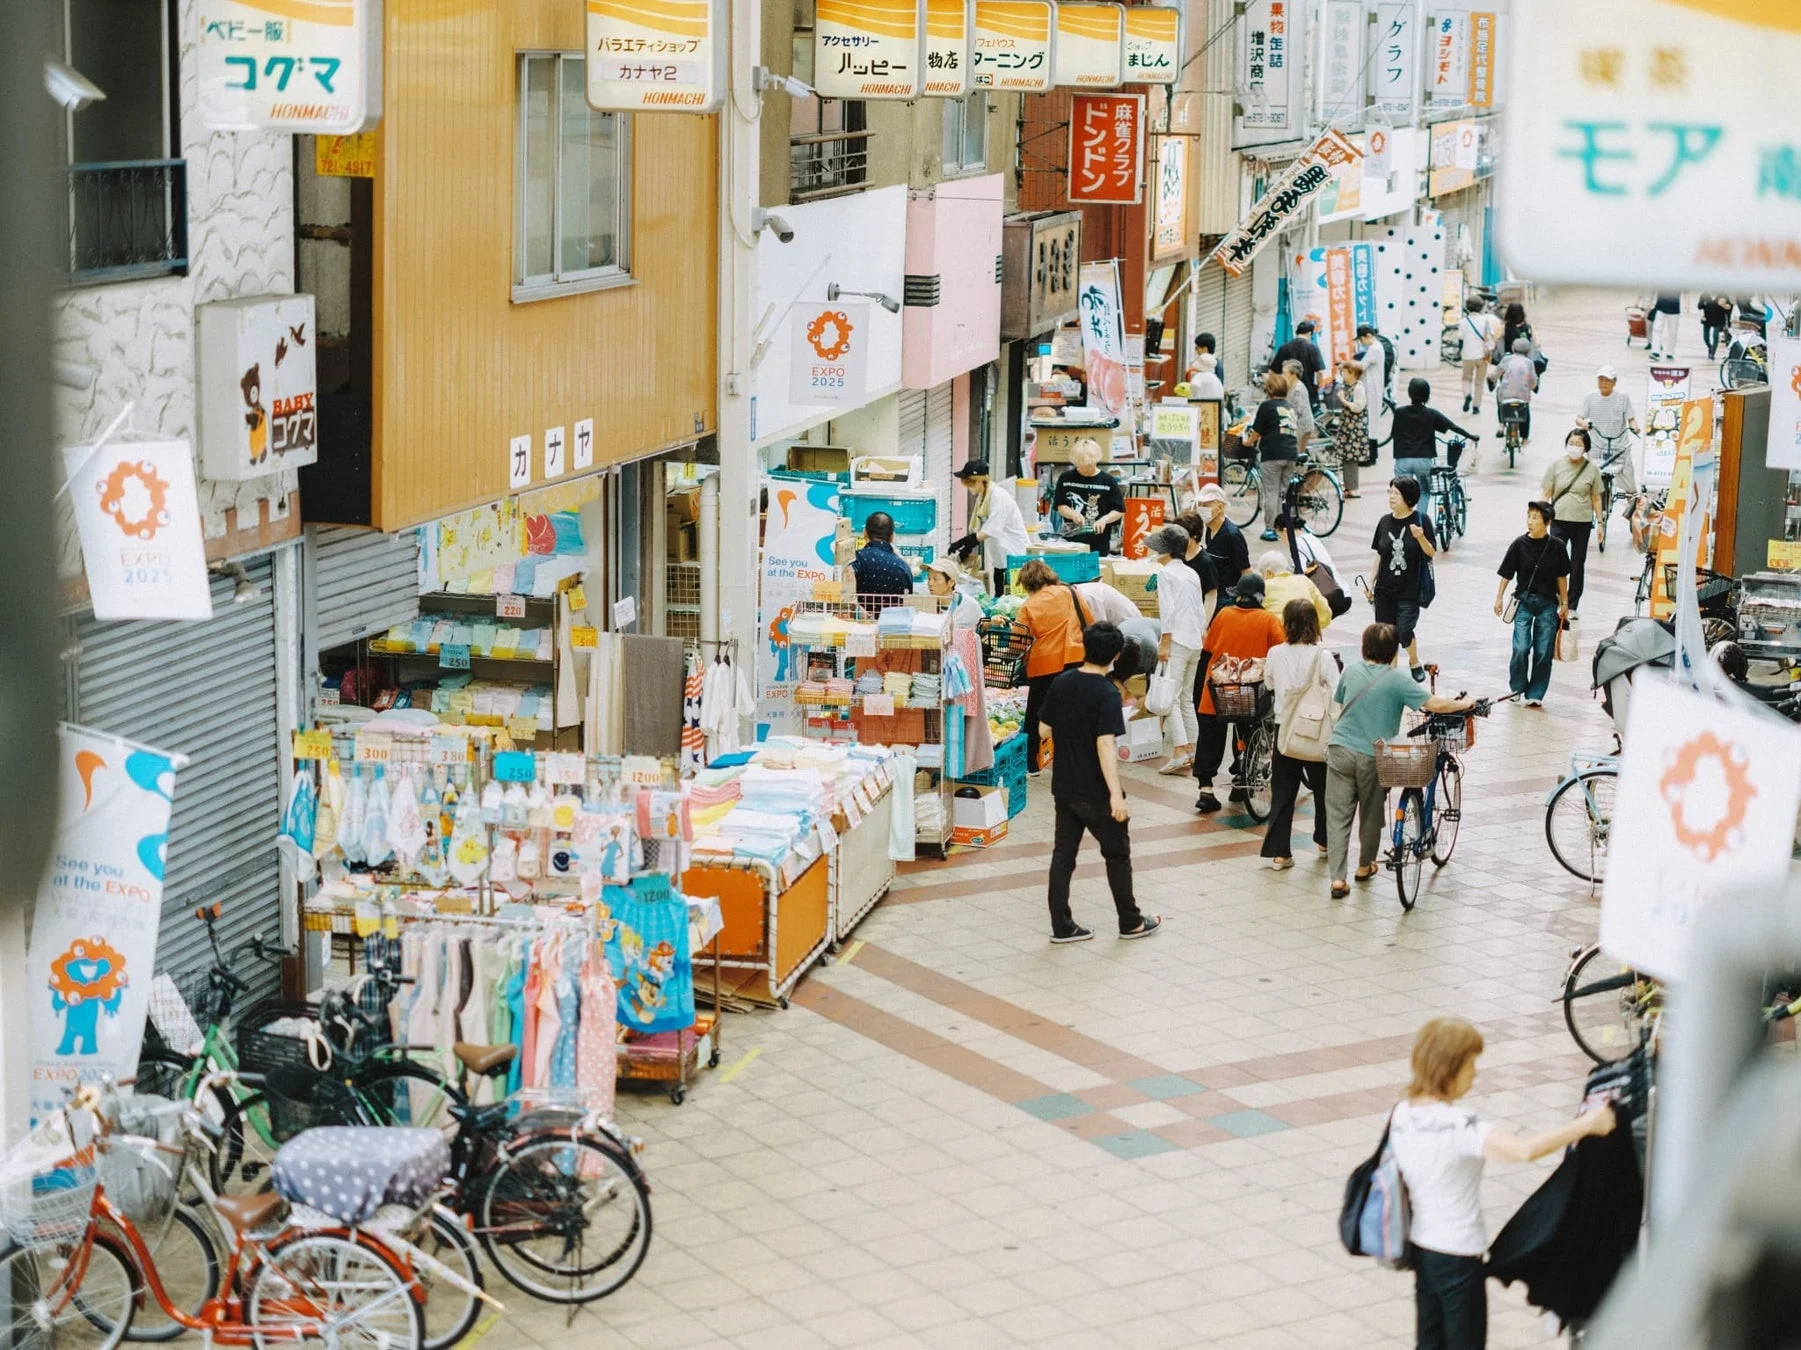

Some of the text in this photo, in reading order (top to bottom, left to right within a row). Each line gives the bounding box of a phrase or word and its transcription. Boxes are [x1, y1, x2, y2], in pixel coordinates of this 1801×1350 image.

[206, 20, 284, 42] ベビー服
[1269, 2, 1285, 68] 果物缶詰
[597, 37, 702, 53] バラエティショップ
[822, 35, 880, 47] アクセサリー
[975, 38, 1016, 49] フェハウス
[1386, 20, 1407, 83] グラフ
[838, 52, 907, 76] ハッピー
[1128, 52, 1170, 67] まじん
[1250, 30, 1265, 90] 増沢商
[225, 56, 342, 94] コグマ
[619, 65, 678, 81] カナヤ2
[1075, 74, 1116, 83] HONMACHI
[860, 83, 912, 95] HONMACHI
[1000, 78, 1044, 88] HONMACHI
[642, 92, 706, 105] HONMACHI
[269, 103, 351, 121] HONMACHI
[1080, 102, 1108, 193] ドンドン
[1113, 103, 1133, 187] 麻雀クラブ
[811, 366, 846, 378] EXPO
[811, 377, 845, 387] 2025
[273, 391, 314, 414] BABY
[274, 411, 314, 449] コグマ
[768, 556, 808, 568] See you
[767, 568, 826, 581] at the EXPO
[504, 606, 521, 616] 220
[449, 657, 468, 668] 250
[766, 690, 788, 699] EXPO
[363, 748, 388, 760] 300
[441, 751, 466, 762] 380
[508, 767, 533, 779] 250
[632, 771, 660, 783] 1200
[55, 855, 124, 878] See you
[53, 873, 151, 903] at the EXPO
